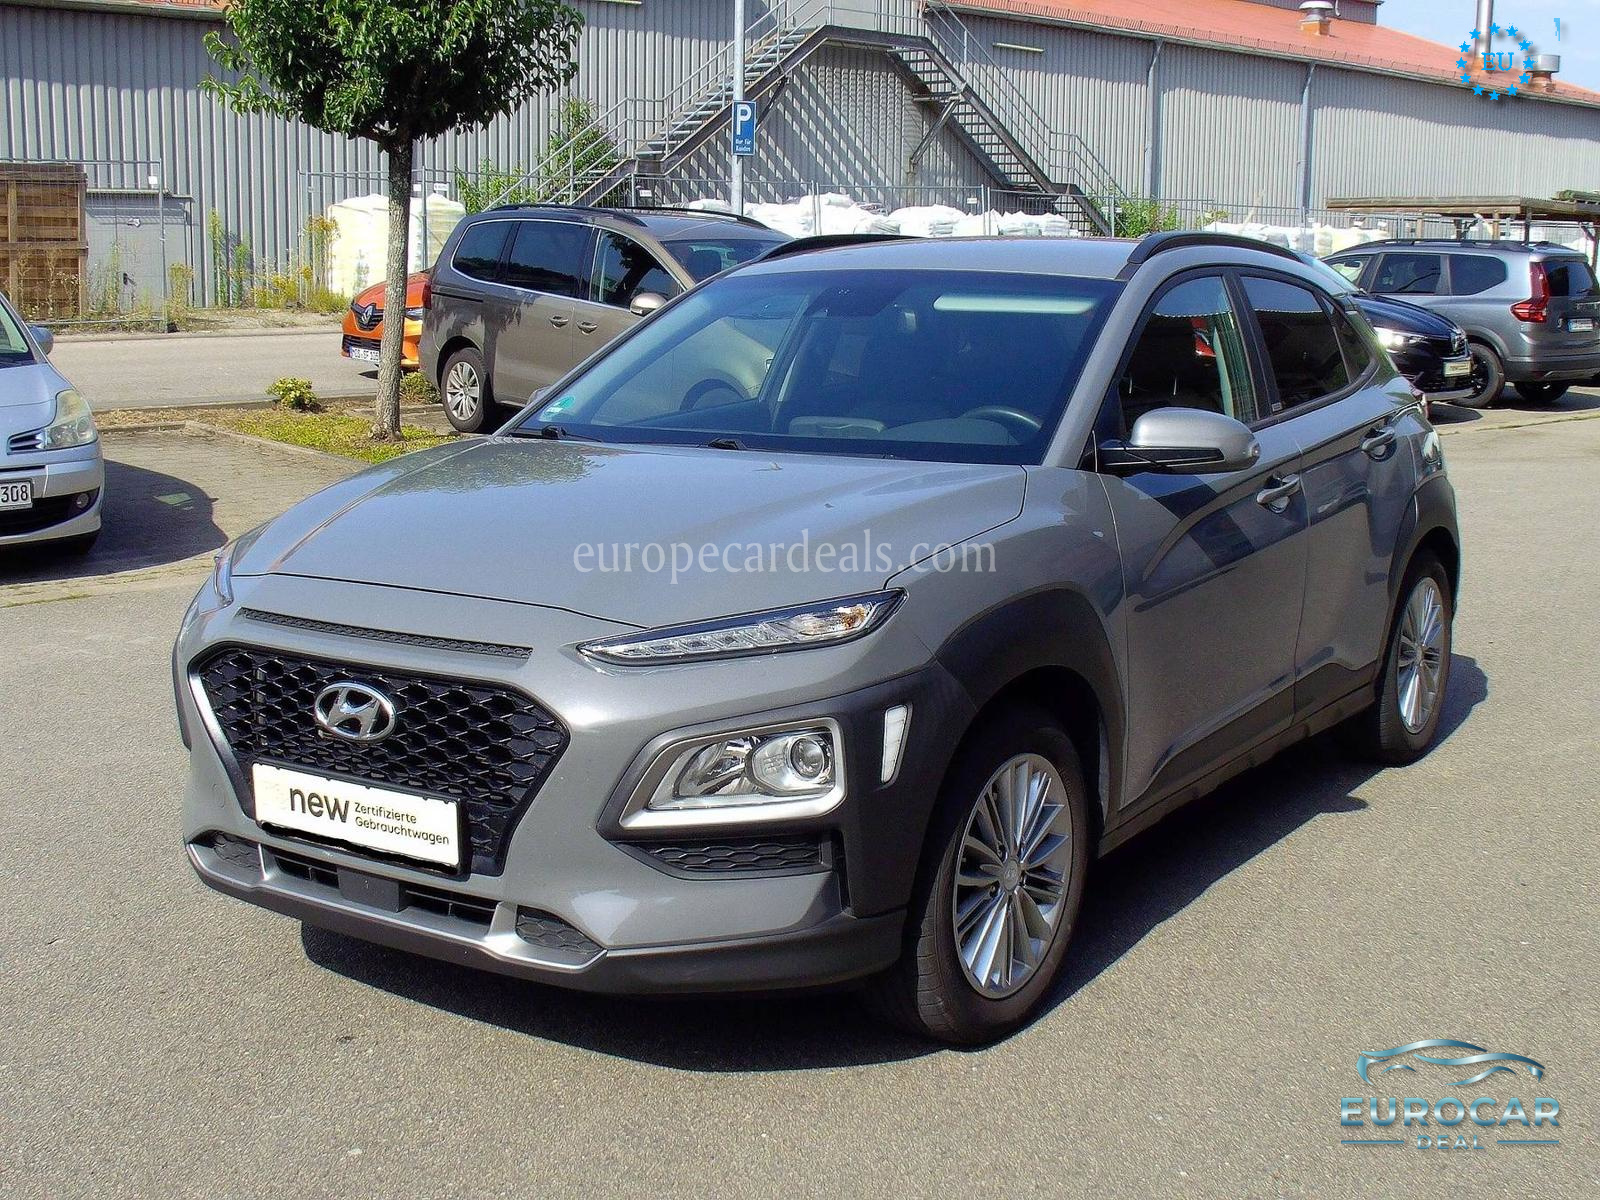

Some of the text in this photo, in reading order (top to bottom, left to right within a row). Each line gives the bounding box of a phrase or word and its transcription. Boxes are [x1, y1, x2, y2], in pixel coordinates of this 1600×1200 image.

[736, 103, 752, 136] P
[0, 484, 28, 503] 308
[289, 787, 350, 823] new
[354, 802, 418, 825] Zertifizierte
[355, 816, 450, 845] Gebrauchtwagen
